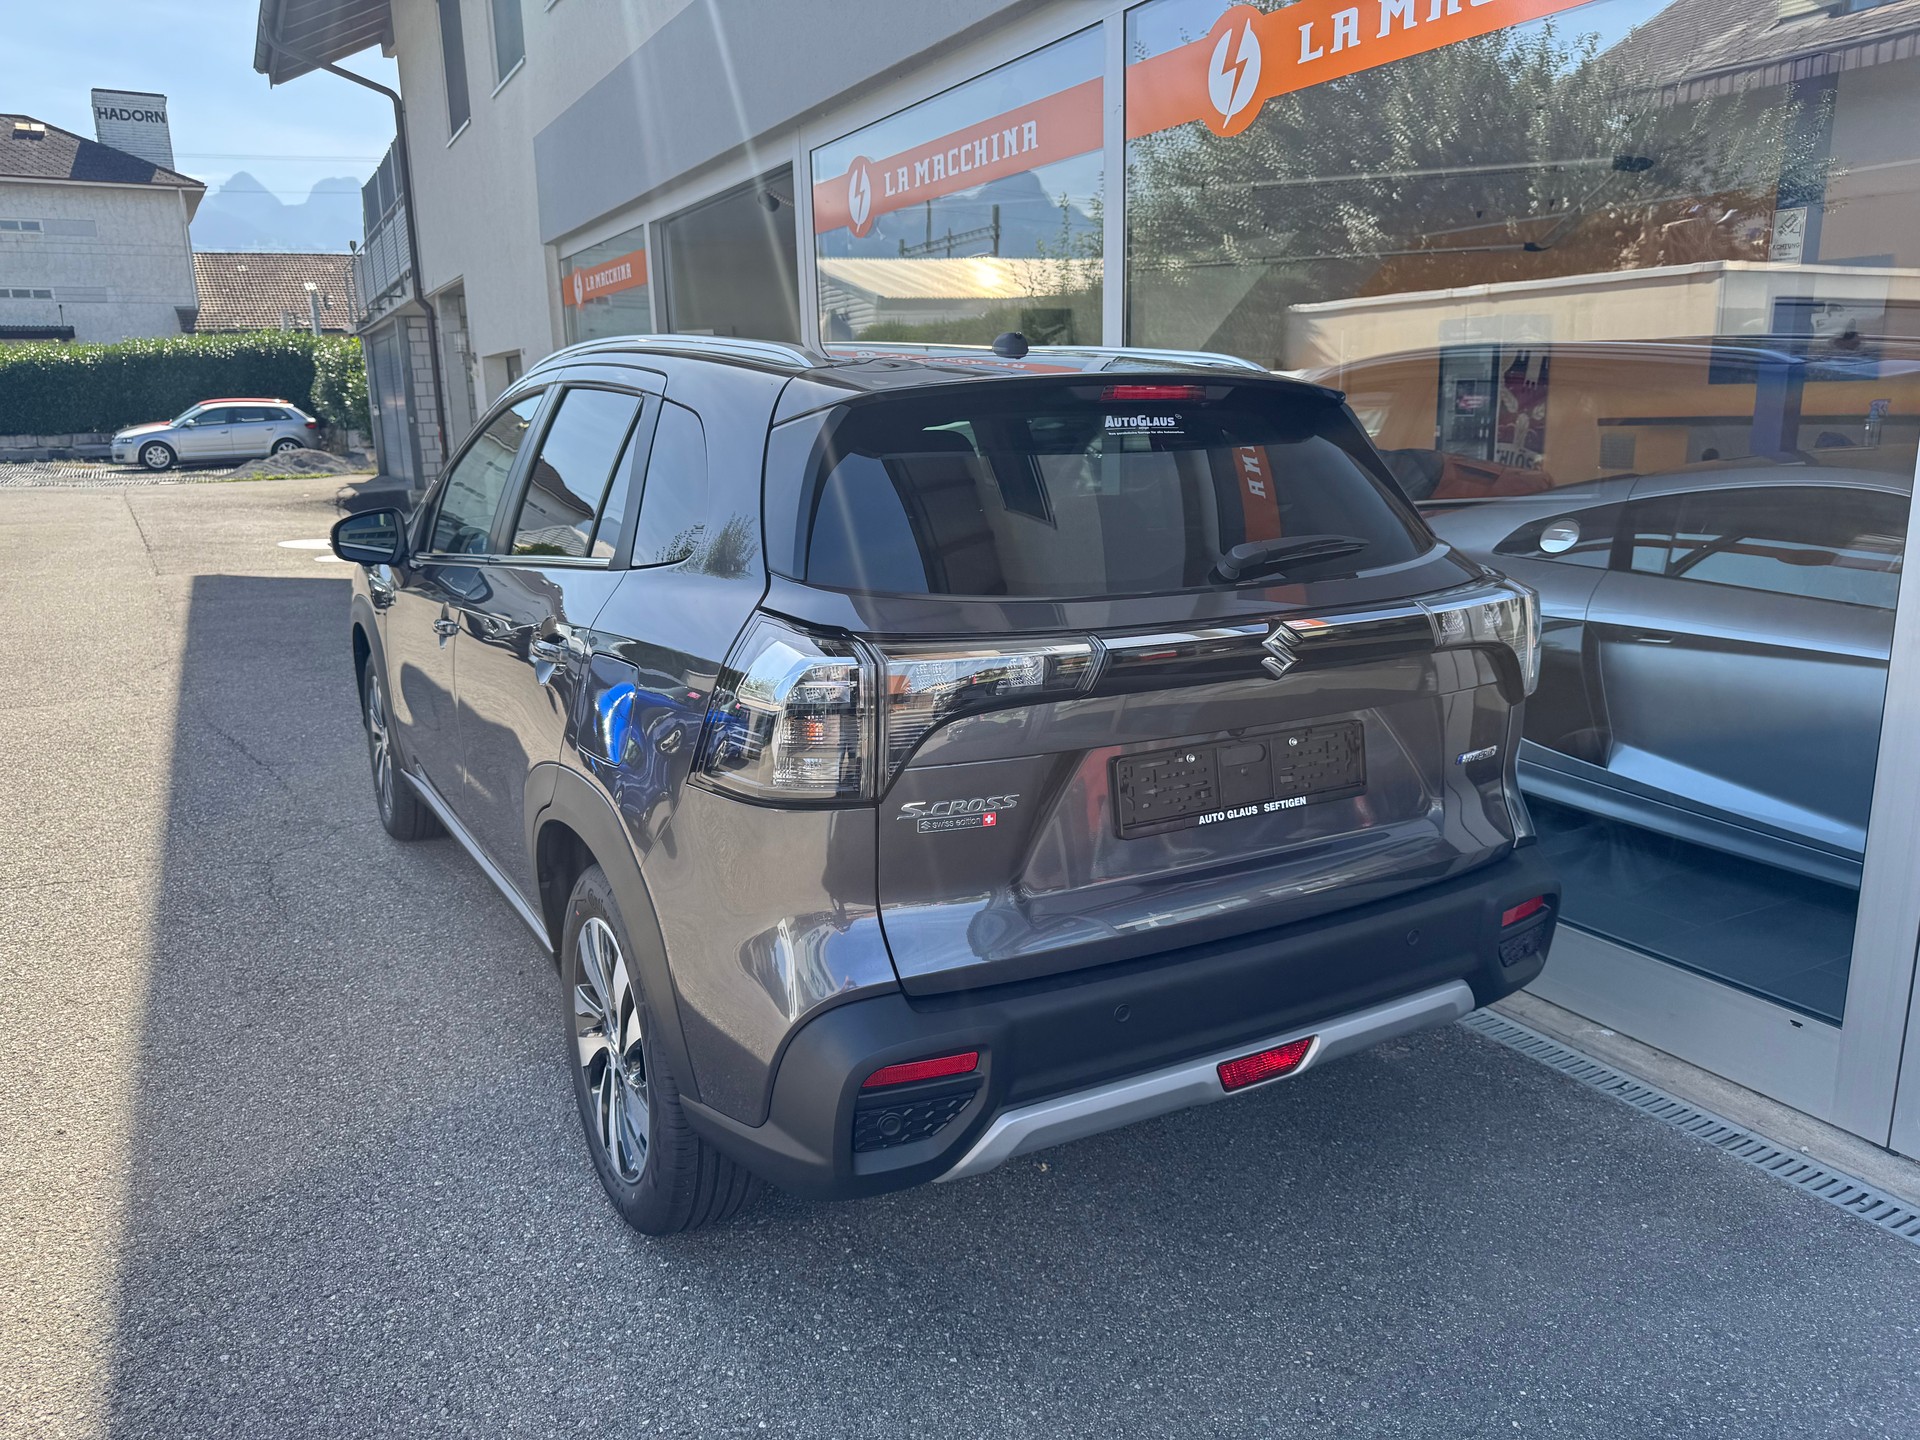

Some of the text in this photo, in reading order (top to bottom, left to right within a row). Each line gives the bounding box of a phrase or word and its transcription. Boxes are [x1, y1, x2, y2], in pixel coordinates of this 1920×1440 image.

[1297, 7, 1361, 64] LA
[97, 107, 166, 124] HADORN
[884, 120, 1039, 198] LA MACCHINA
[585, 262, 632, 291] LA MACCHINA
[932, 819, 954, 829] swiss
[1199, 796, 1307, 825] AUTO GLAUS SEFTIGEN
